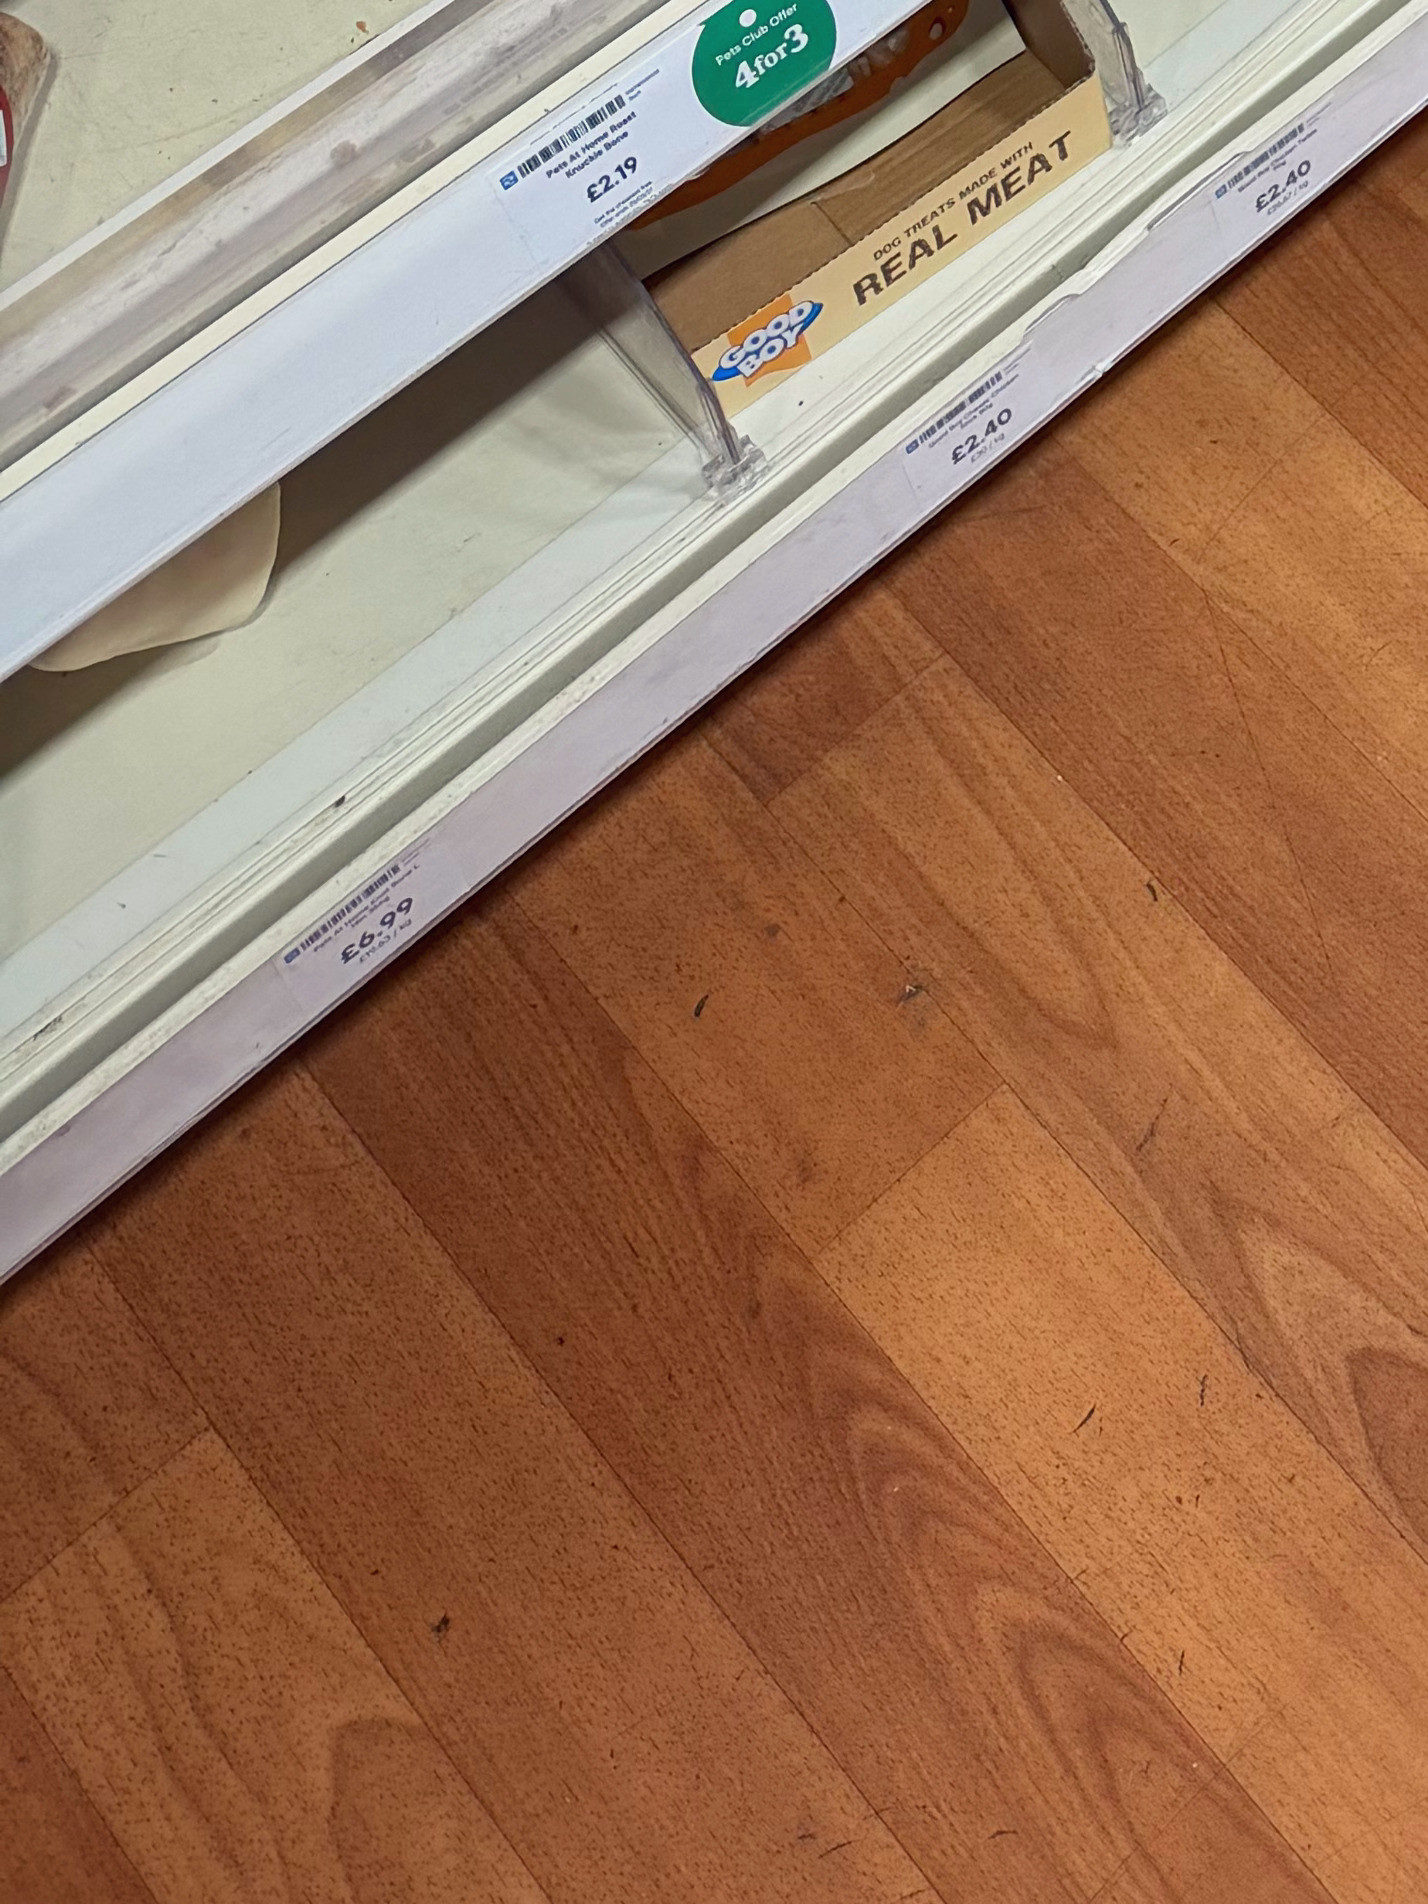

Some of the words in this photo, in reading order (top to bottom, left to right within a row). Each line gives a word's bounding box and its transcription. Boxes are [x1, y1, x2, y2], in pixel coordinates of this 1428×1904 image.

[734, 23, 809, 90] 4for3
[586, 156, 638, 204] £2.19
[1256, 160, 1311, 213] £2.40
[852, 224, 958, 306] REAL
[966, 130, 1073, 227] MEAT
[719, 300, 814, 371] GOOD
[738, 322, 804, 377] BOY
[952, 408, 1012, 465] £2.40
[340, 896, 415, 965] £6.99
